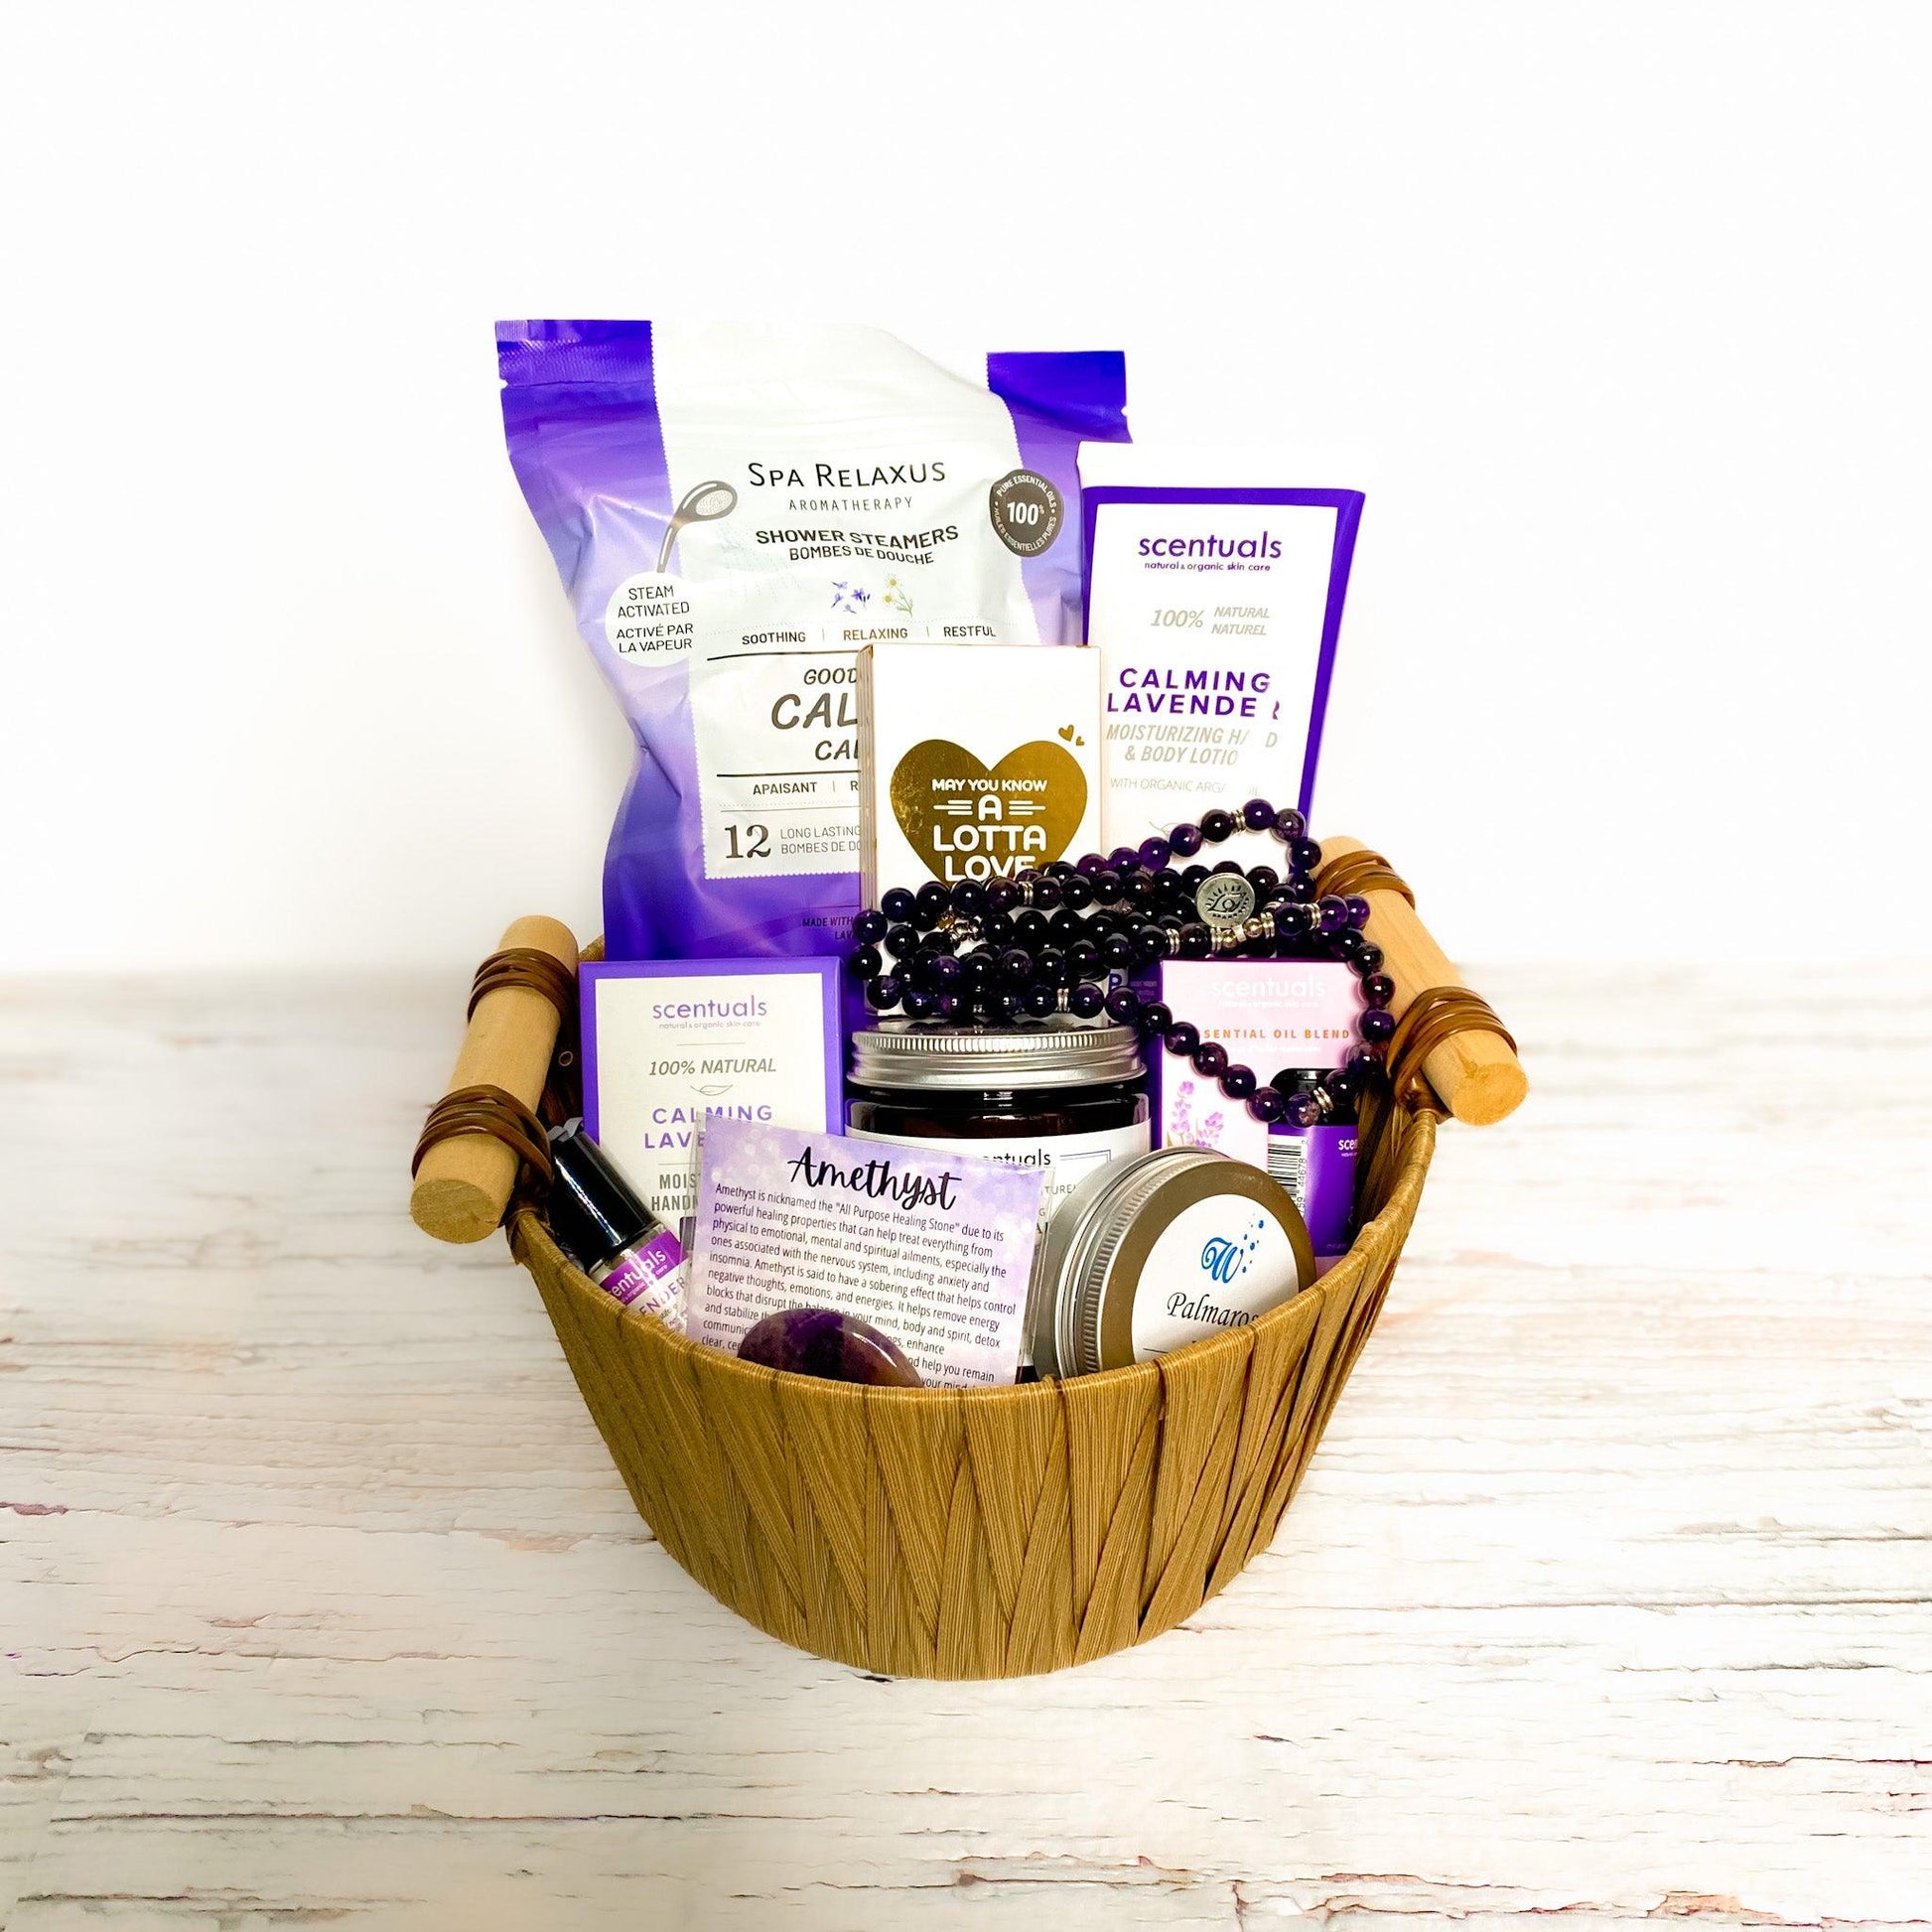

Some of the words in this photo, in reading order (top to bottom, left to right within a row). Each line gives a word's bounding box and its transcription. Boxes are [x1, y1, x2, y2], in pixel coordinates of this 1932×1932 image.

[996, 479, 1015, 496] PURE
[1013, 475, 1048, 493] ESSENTIAL
[788, 496, 912, 511] AROMATHERAPY
[756, 529, 845, 545] SHOWER
[850, 525, 960, 550] STEAMERS
[1138, 531, 1283, 559] scentuals
[789, 545, 853, 562] BOMBES
[854, 547, 876, 559] DE
[877, 549, 933, 565] DOUCHE
[1144, 561, 1179, 572] natural
[1186, 562, 1224, 573] organic
[1226, 562, 1245, 572] skin
[1247, 564, 1272, 573] care
[627, 585, 674, 601] STEAM
[618, 601, 691, 619] ACTIVATED
[1150, 609, 1205, 629] 100%
[1212, 606, 1273, 620] NATURAL
[617, 622, 664, 639] ACTIVÉ
[667, 622, 695, 636] PAR
[742, 631, 807, 645] SOOTHING
[843, 627, 909, 641] RELAXING
[943, 625, 997, 637] RESTFUL
[1210, 622, 1269, 636] NATUREL
[620, 641, 638, 653] LA
[640, 637, 693, 652] VAPEUR
[1118, 667, 1271, 694] CALMING
[1105, 724, 1225, 746] MOISTURIZING
[1227, 729, 1279, 749] HD
[1124, 745, 1137, 762] &
[1140, 746, 1188, 764] BODY
[1189, 748, 1240, 766] LOTIO
[753, 781, 818, 796] APAISANT
[931, 778, 967, 792] MAY
[966, 778, 1000, 792] YOU
[1001, 779, 1048, 793] KNOW
[1110, 777, 1139, 791] WITH
[1140, 777, 1193, 792] ORGANIC
[978, 794, 1003, 821] A
[725, 824, 772, 860] 12
[779, 827, 812, 840] LONG
[813, 825, 862, 839] LASTING
[933, 824, 1047, 853] LOTTA
[780, 841, 829, 855] BOMBES
[831, 840, 848, 853] DE
[801, 916, 828, 928] MADE
[829, 915, 854, 927] WITH
[1210, 973, 1327, 999] scentuals
[652, 994, 768, 1020] scentuals
[658, 1021, 689, 1030] natural
[694, 1020, 725, 1030] organic
[743, 1019, 761, 1028] care
[1273, 1029, 1298, 1040] OIL
[1304, 1029, 1351, 1040] BLEND
[648, 1059, 696, 1076] 100%
[700, 1057, 778, 1074] NATURAL
[651, 1104, 773, 1125] CALMING
[786, 1146, 963, 1210] Amethyst
[716, 1183, 757, 1200] Amethyst
[758, 1189, 766, 1202] is
[767, 1192, 817, 1210] nicknamed
[818, 1199, 833, 1213] the
[836, 1202, 852, 1215] "All
[853, 1205, 891, 1222] Purpose
[893, 1212, 927, 1232] Healing
[928, 1218, 960, 1233] Stone"
[961, 1223, 980, 1238] due
[982, 1228, 992, 1240] to
[993, 1229, 1005, 1242] its
[714, 1202, 755, 1217] powerful
[756, 1206, 789, 1226] healing
[790, 1215, 837, 1231] properties
[839, 1220, 857, 1235] that
[858, 1226, 875, 1237] can
[876, 1227, 897, 1244] help
[898, 1232, 920, 1246] treat
[922, 1238, 969, 1257] everything
[971, 1242, 993, 1258] from
[712, 1217, 749, 1233] physical
[750, 1224, 759, 1236] to
[760, 1228, 808, 1245] emotional,
[810, 1236, 842, 1249] mental
[843, 1241, 862, 1253] and
[863, 1244, 900, 1259] spiritual
[901, 1250, 942, 1268] ailments,
[945, 1259, 990, 1278] especially
[991, 1264, 1007, 1279] the
[711, 1236, 733, 1248] ones
[735, 1240, 780, 1256] associated
[782, 1247, 802, 1260] with
[803, 1249, 819, 1263] the
[820, 1255, 856, 1269] nervous
[858, 1261, 891, 1277] system,
[894, 1266, 935, 1286] including
[937, 1275, 970, 1292] anxiety
[971, 1281, 990, 1293] and
[710, 1251, 753, 1268] insomnia.
[755, 1259, 795, 1277] Amethyst
[796, 1265, 805, 1278] is
[806, 1269, 825, 1281] said
[826, 1272, 837, 1283] to
[838, 1272, 860, 1287] have
[861, 1278, 868, 1289] a
[869, 1280, 908, 1299] sobering
[909, 1286, 935, 1301] effect
[936, 1291, 955, 1305] that
[956, 1294, 982, 1311] helps
[983, 1302, 1017, 1315] control
[708, 1270, 745, 1285] negative
[747, 1275, 787, 1293] thoughts,
[789, 1284, 833, 1301] emotions,
[835, 1291, 854, 1304] and
[855, 1296, 895, 1311] energies.
[897, 1301, 904, 1312] It
[906, 1302, 931, 1318] helps
[932, 1310, 967, 1324] remove
[969, 1316, 1001, 1332] energy
[705, 1303, 723, 1314] and
[725, 1307, 759, 1322] stabilize
[706, 1284, 734, 1300] blocks
[736, 1290, 754, 1304] that
[756, 1293, 786, 1310] disrupt
[875, 1314, 900, 1330] mind,
[902, 1318, 926, 1336] body
[927, 1325, 946, 1338] and
[947, 1329, 972, 1344] spirit,
[974, 1333, 1001, 1349] detox
[701, 1335, 725, 1349] clear,
[906, 1339, 945, 1355] enhance
[921, 1357, 942, 1375] help
[943, 1364, 961, 1377] you
[962, 1368, 995, 1383] remain
